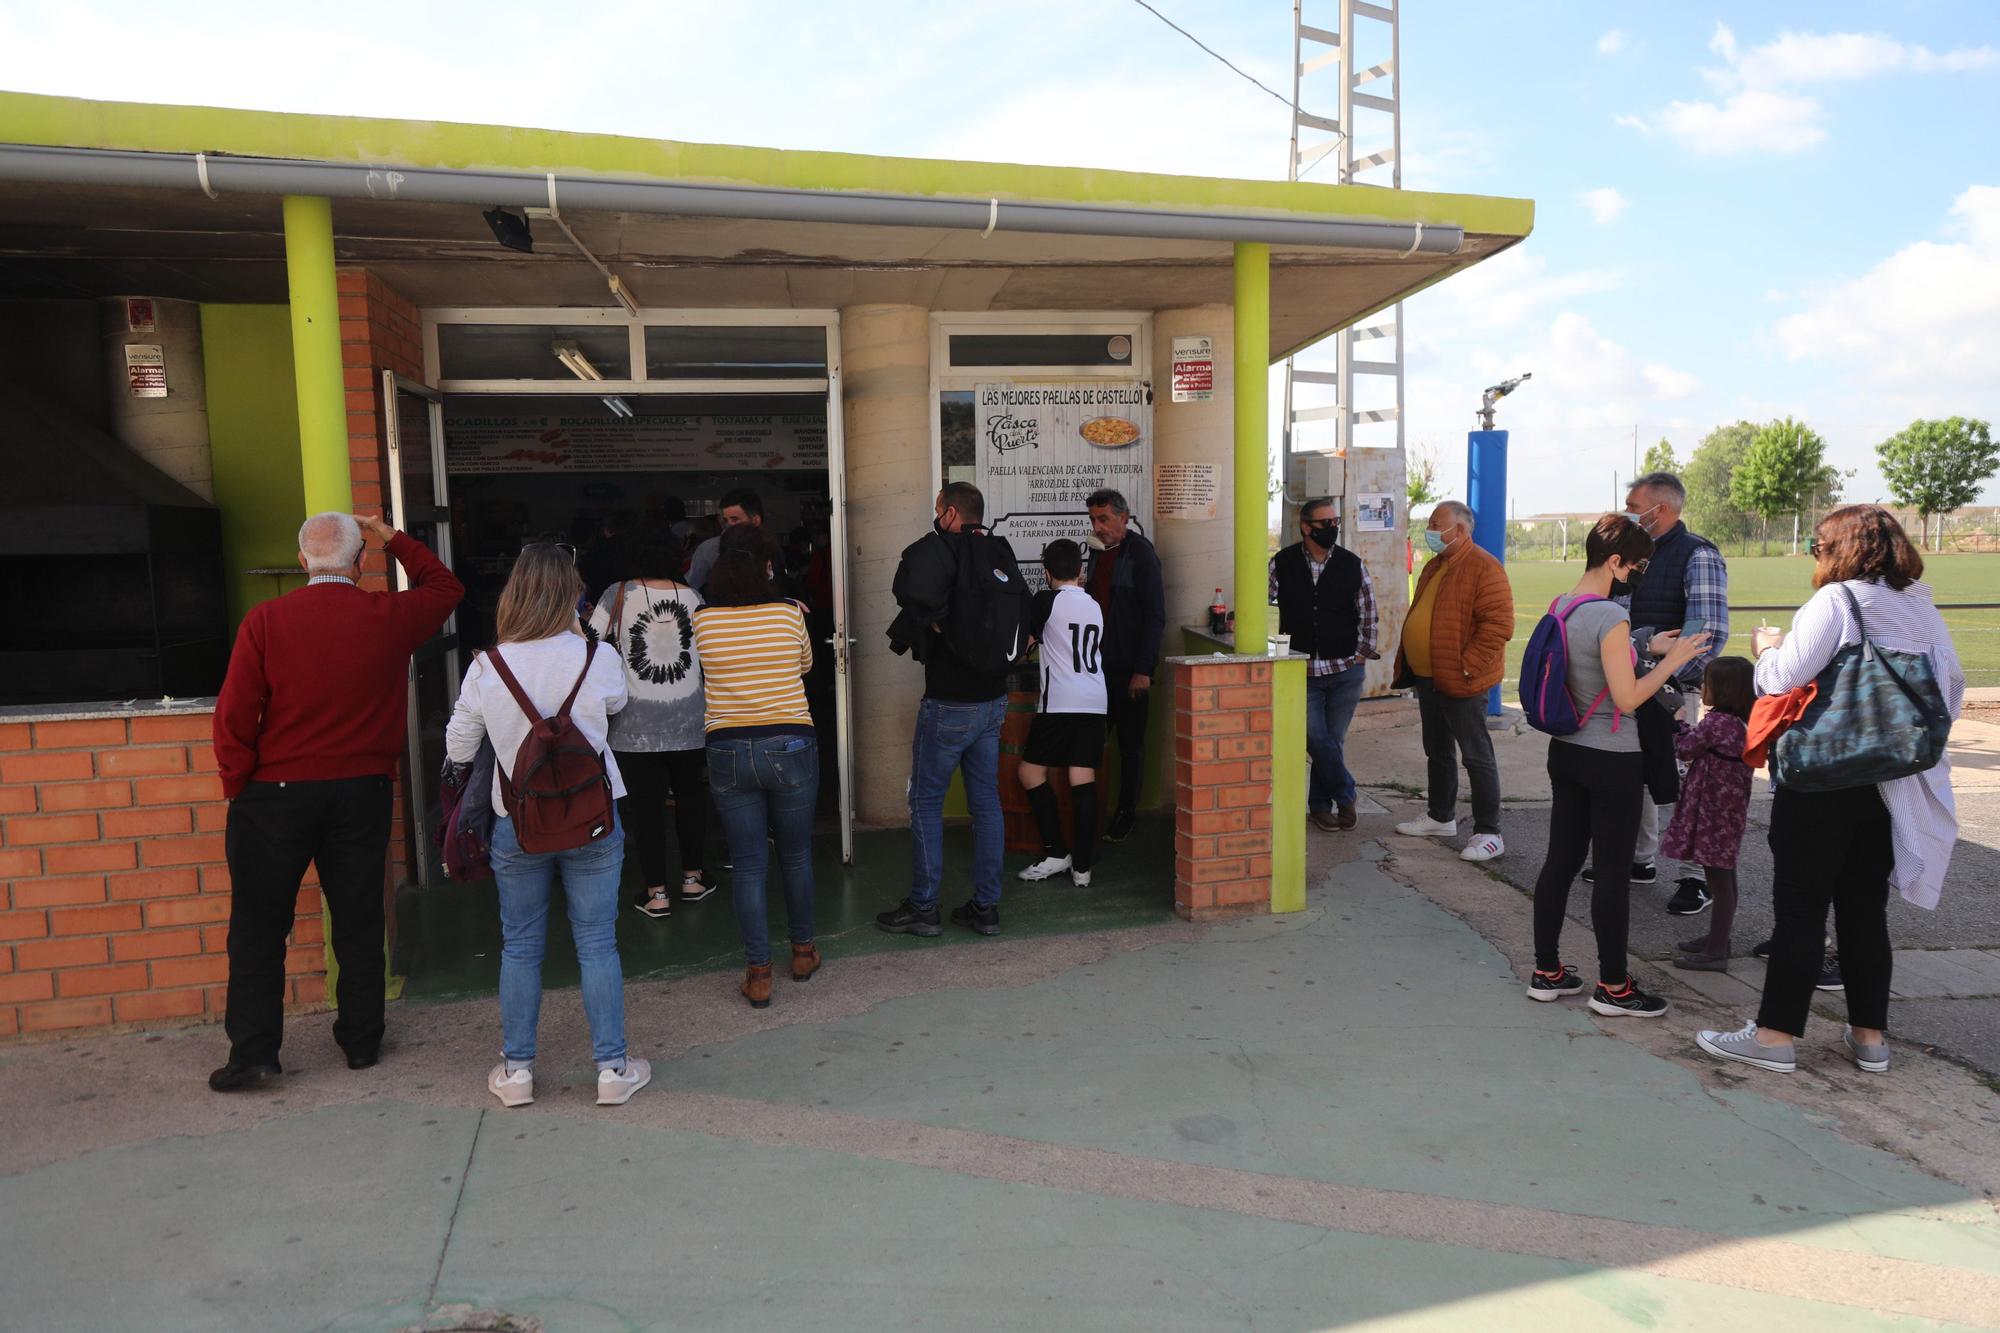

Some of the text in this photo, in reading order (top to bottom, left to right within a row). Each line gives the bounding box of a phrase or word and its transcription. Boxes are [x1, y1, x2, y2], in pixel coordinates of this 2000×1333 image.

[1175, 348, 1211, 356] verisure
[1175, 364, 1212, 373] Alarma
[982, 391, 999, 406] LAS
[1001, 390, 1040, 406] MEJORES
[1043, 390, 1081, 405] PAELLAS
[1083, 390, 1094, 405] DE
[446, 417, 518, 427] OCADILLOS
[560, 416, 625, 426] BOCADILLOS
[628, 416, 687, 425] ESPECIALES
[712, 416, 761, 425] TOSTADAS
[987, 414, 1038, 430] Tasca
[988, 429, 1040, 455] Puerto
[1018, 465, 1064, 476] VALENCIANA
[1065, 465, 1075, 475] DE
[1077, 465, 1103, 475] CARNE
[1103, 465, 1108, 475] Y
[1109, 464, 1144, 475] VERDURA
[1055, 479, 1070, 488] DEL
[1071, 476, 1105, 488] SEÑORET
[1059, 492, 1069, 501] DE
[1009, 518, 1037, 528] RACIÓN
[1046, 519, 1084, 528] ENSALADA
[1022, 529, 1054, 538] TARRINA
[1056, 529, 1066, 537] DE
[1067, 529, 1092, 537] HELAD
[1068, 623, 1100, 674] 10
